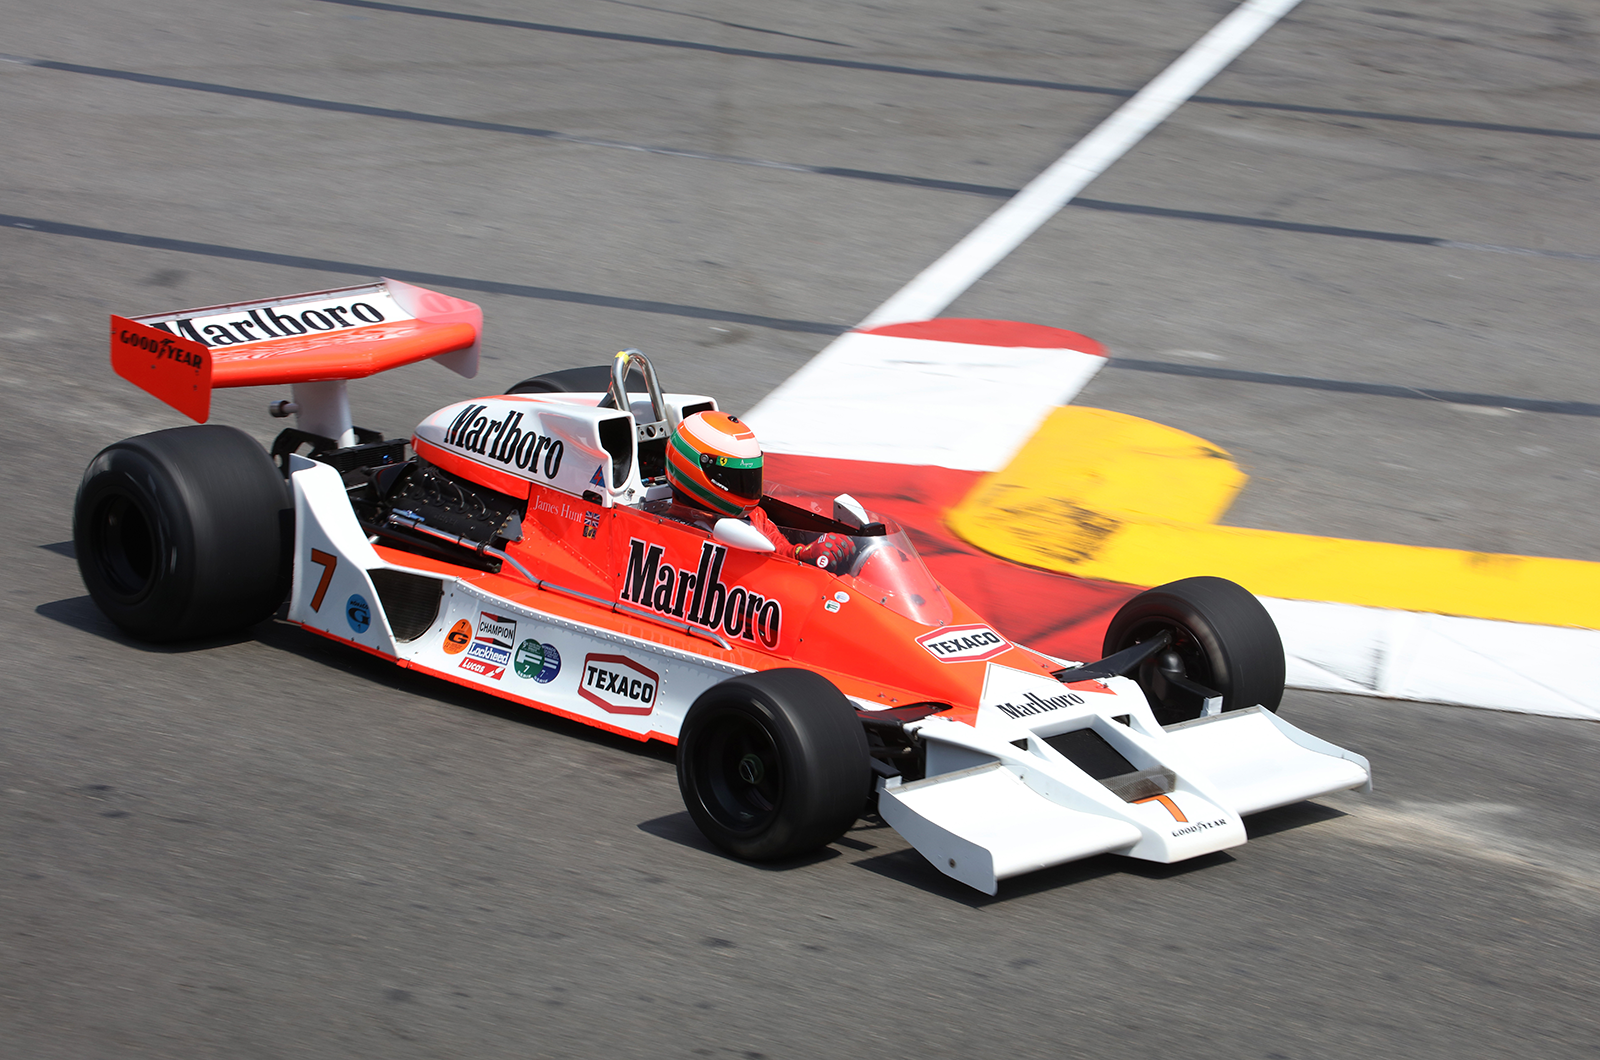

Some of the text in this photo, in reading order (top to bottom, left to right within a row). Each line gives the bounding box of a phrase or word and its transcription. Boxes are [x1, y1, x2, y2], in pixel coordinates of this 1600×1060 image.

[120, 330, 203, 370] GOODYEAR
[444, 404, 564, 480] Marlboro
[533, 495, 583, 523] James Hunt
[310, 548, 337, 613] 7
[620, 537, 781, 649] Marlboro
[348, 607, 370, 626] G
[479, 621, 514, 640] CHAMPION
[448, 631, 469, 645] G
[928, 626, 1001, 656] TEXACO
[461, 658, 485, 673] Lucas
[468, 643, 509, 664] Lockheed
[523, 664, 530, 673] 7
[587, 664, 654, 704] TEXACO
[995, 691, 1086, 720] Marlboro
[1171, 818, 1227, 837] GOODYEAR
